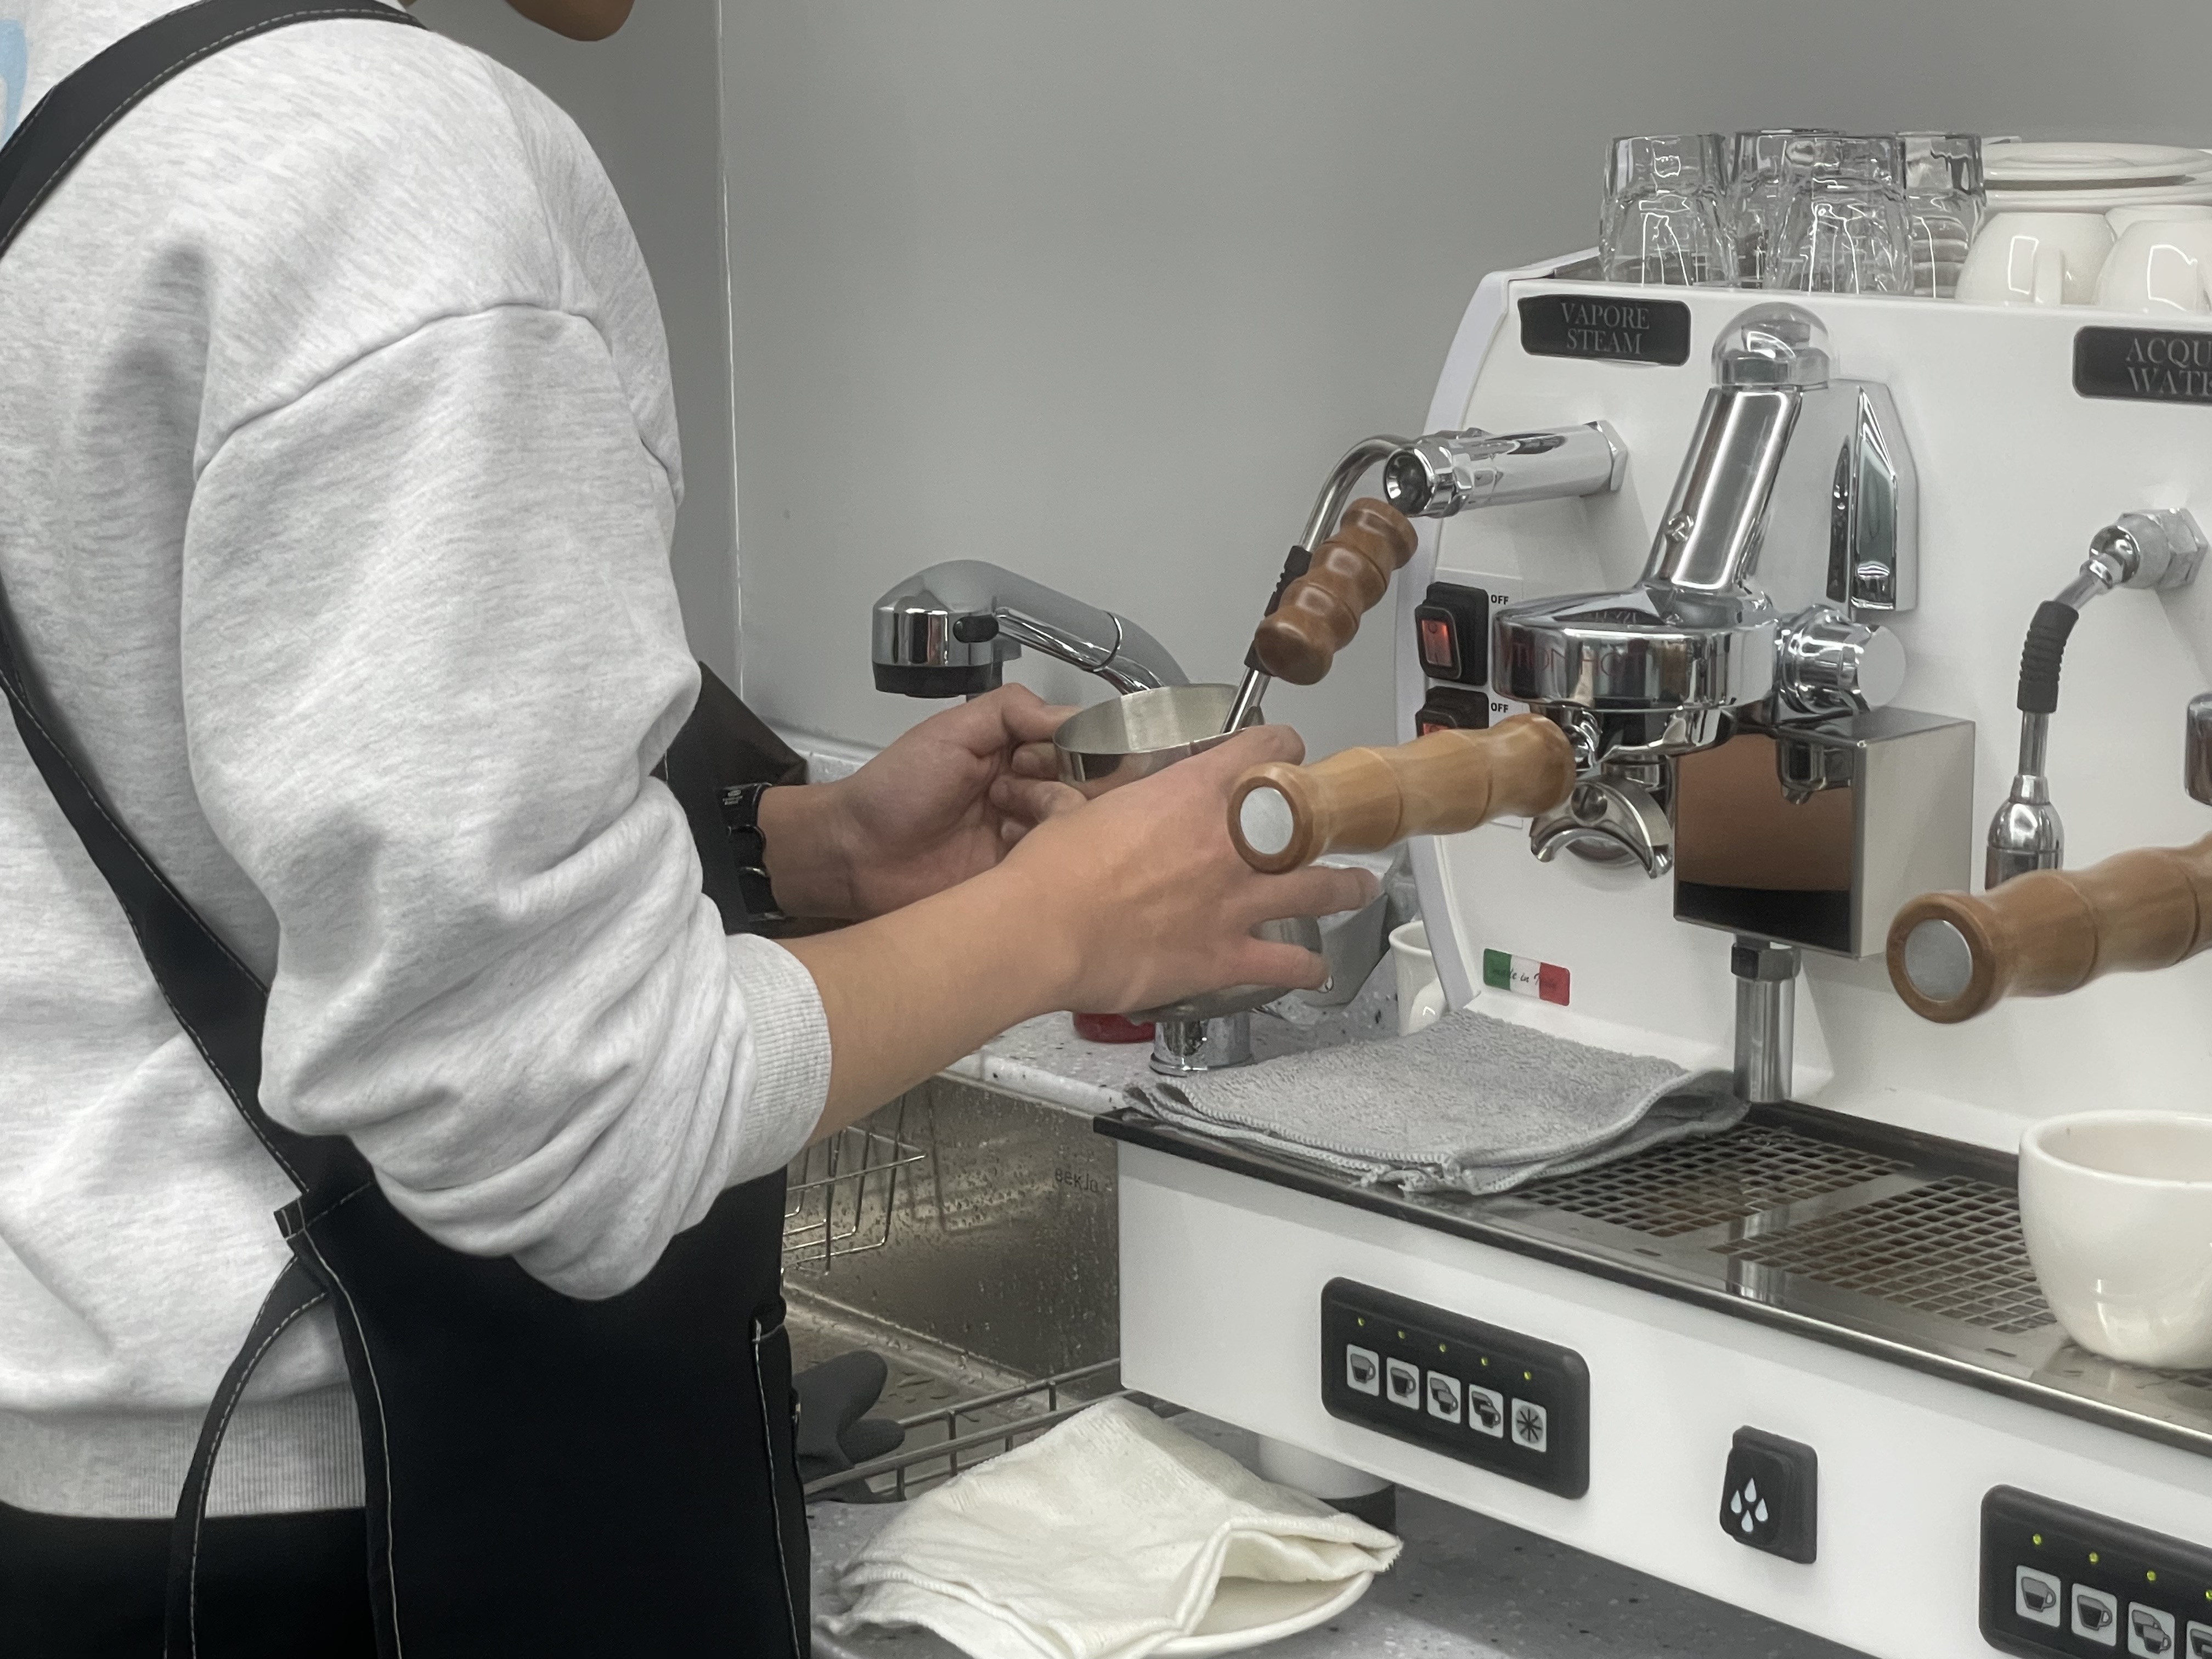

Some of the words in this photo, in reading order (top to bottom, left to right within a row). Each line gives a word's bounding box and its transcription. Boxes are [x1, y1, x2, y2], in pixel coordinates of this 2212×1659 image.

[1560, 302, 1650, 330] VAPORE
[1566, 328, 1643, 354] STEAM
[1491, 594, 1509, 605] OFF
[1491, 702, 1509, 713] OFF
